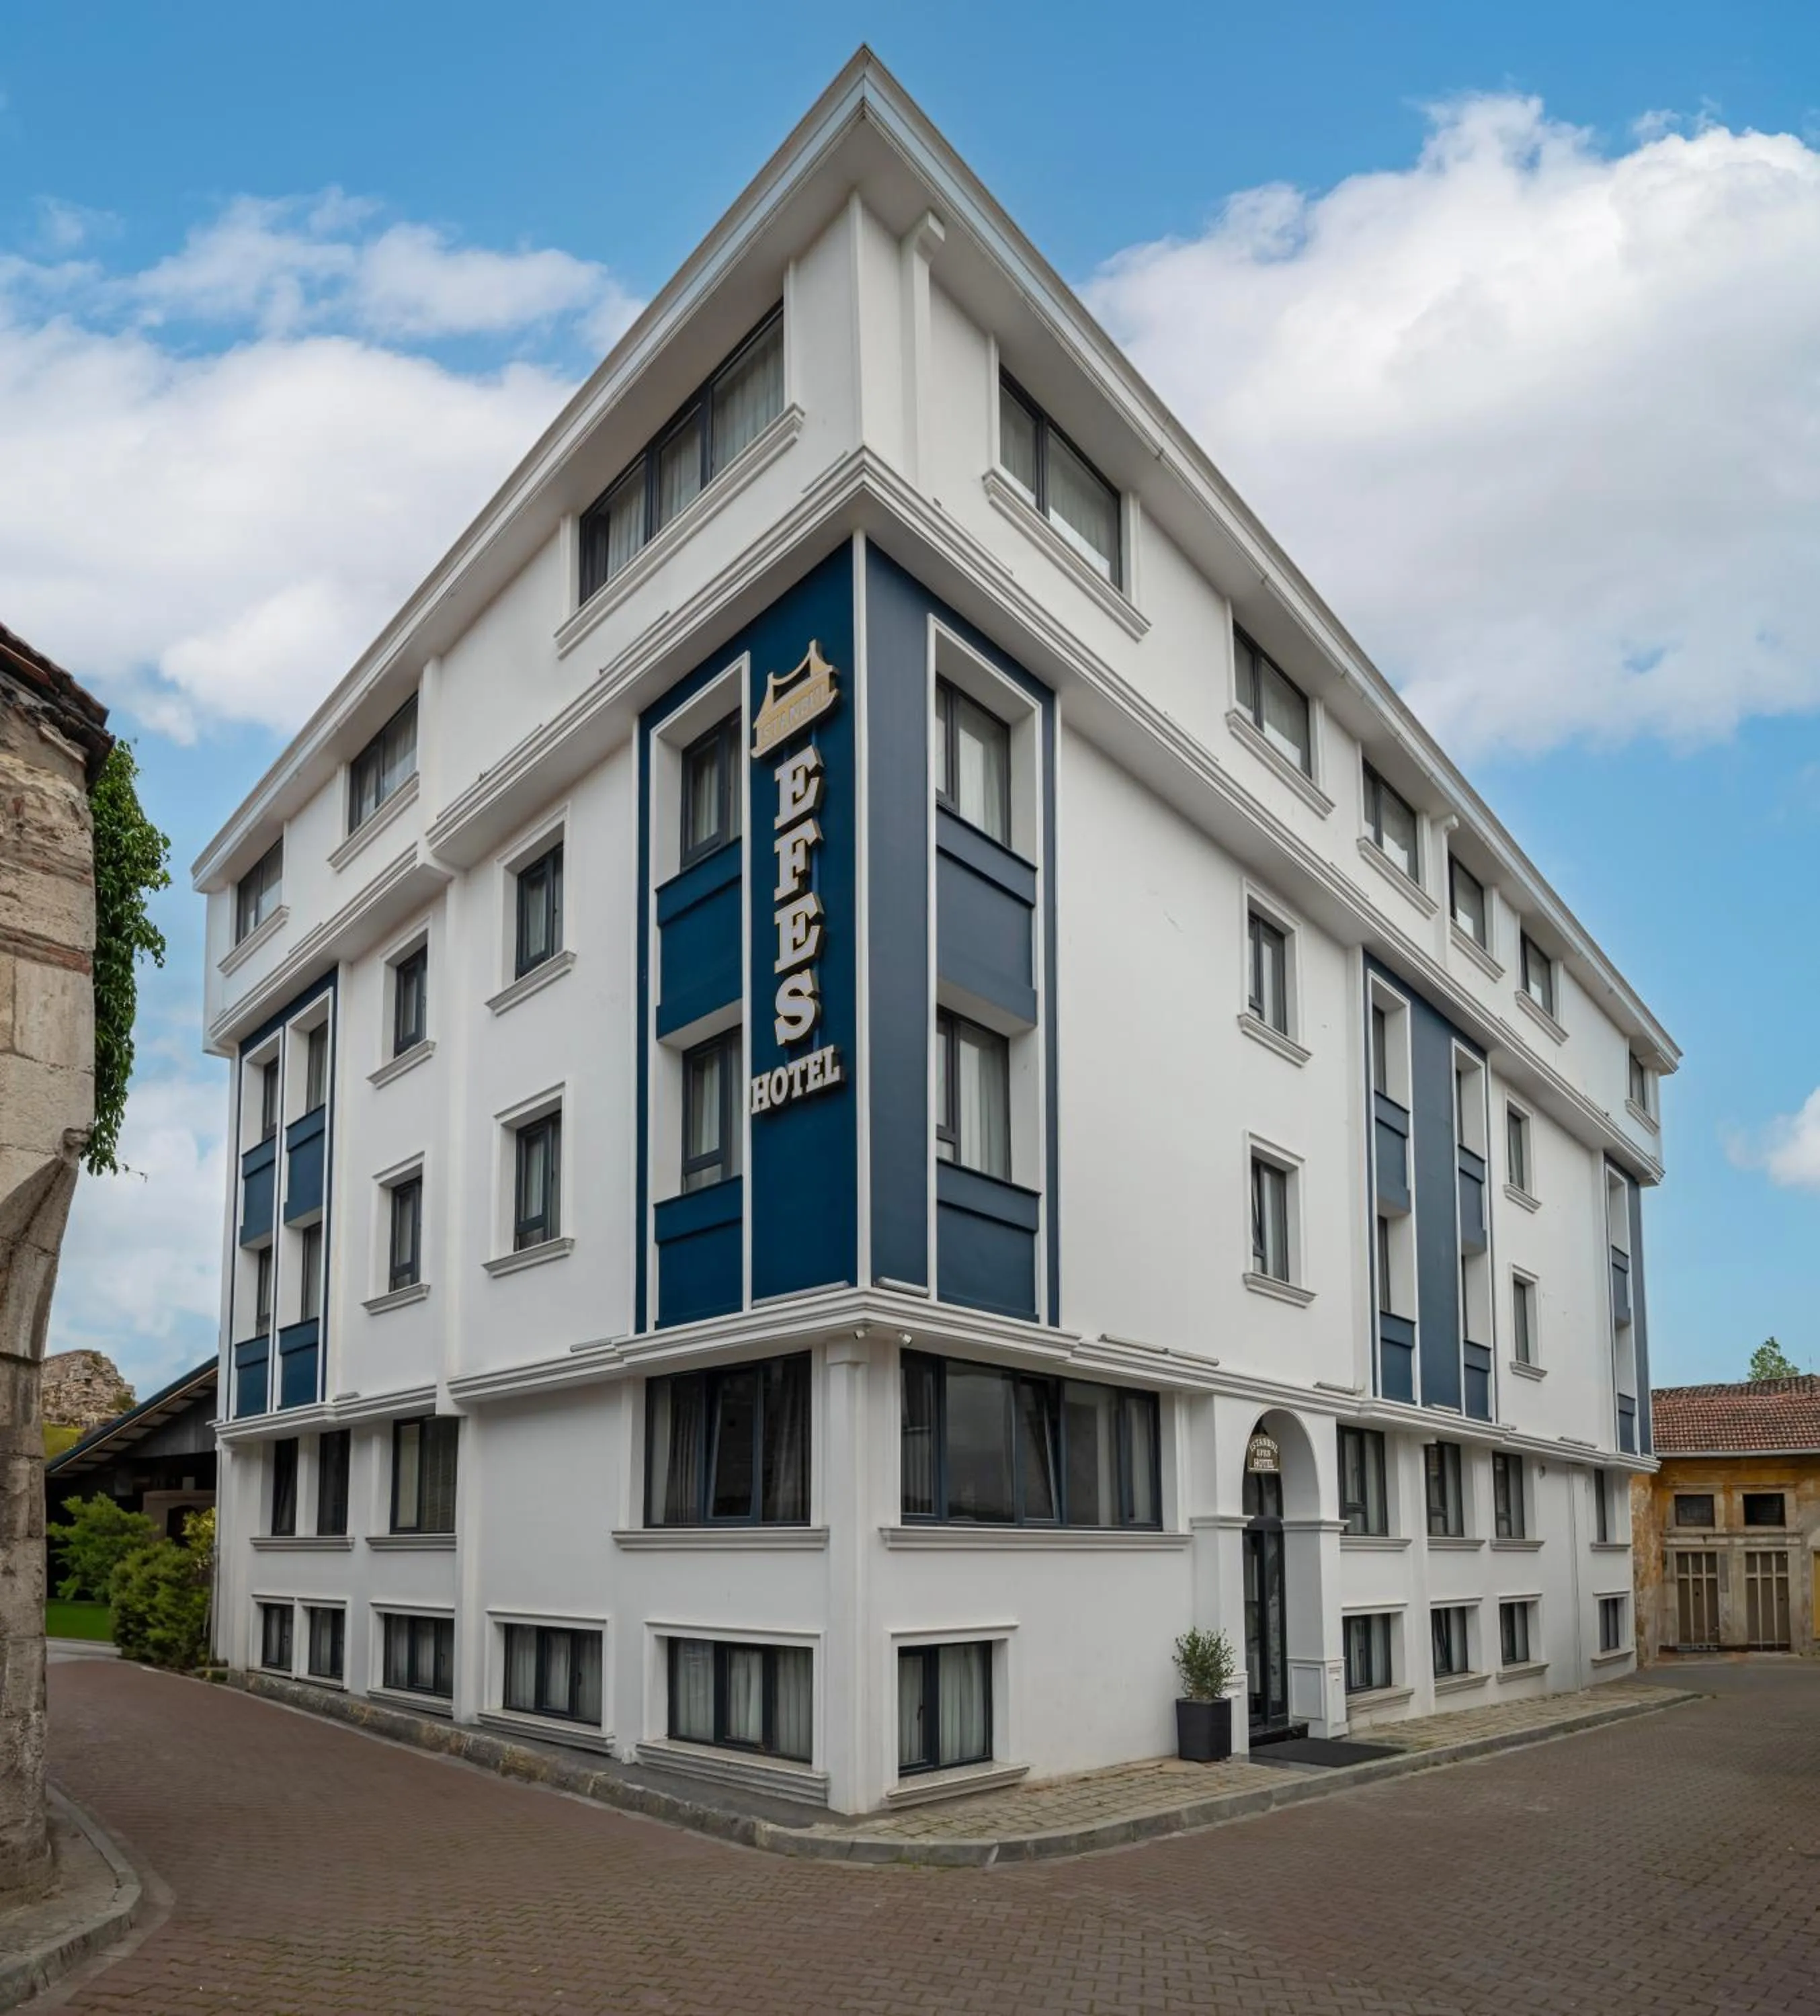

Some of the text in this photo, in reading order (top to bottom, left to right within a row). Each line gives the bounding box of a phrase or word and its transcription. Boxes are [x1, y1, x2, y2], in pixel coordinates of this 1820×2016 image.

[774, 745, 821, 1046] EFES
[751, 1044, 841, 1115] HOTEL
[1253, 1458, 1274, 1468] HOTEL
